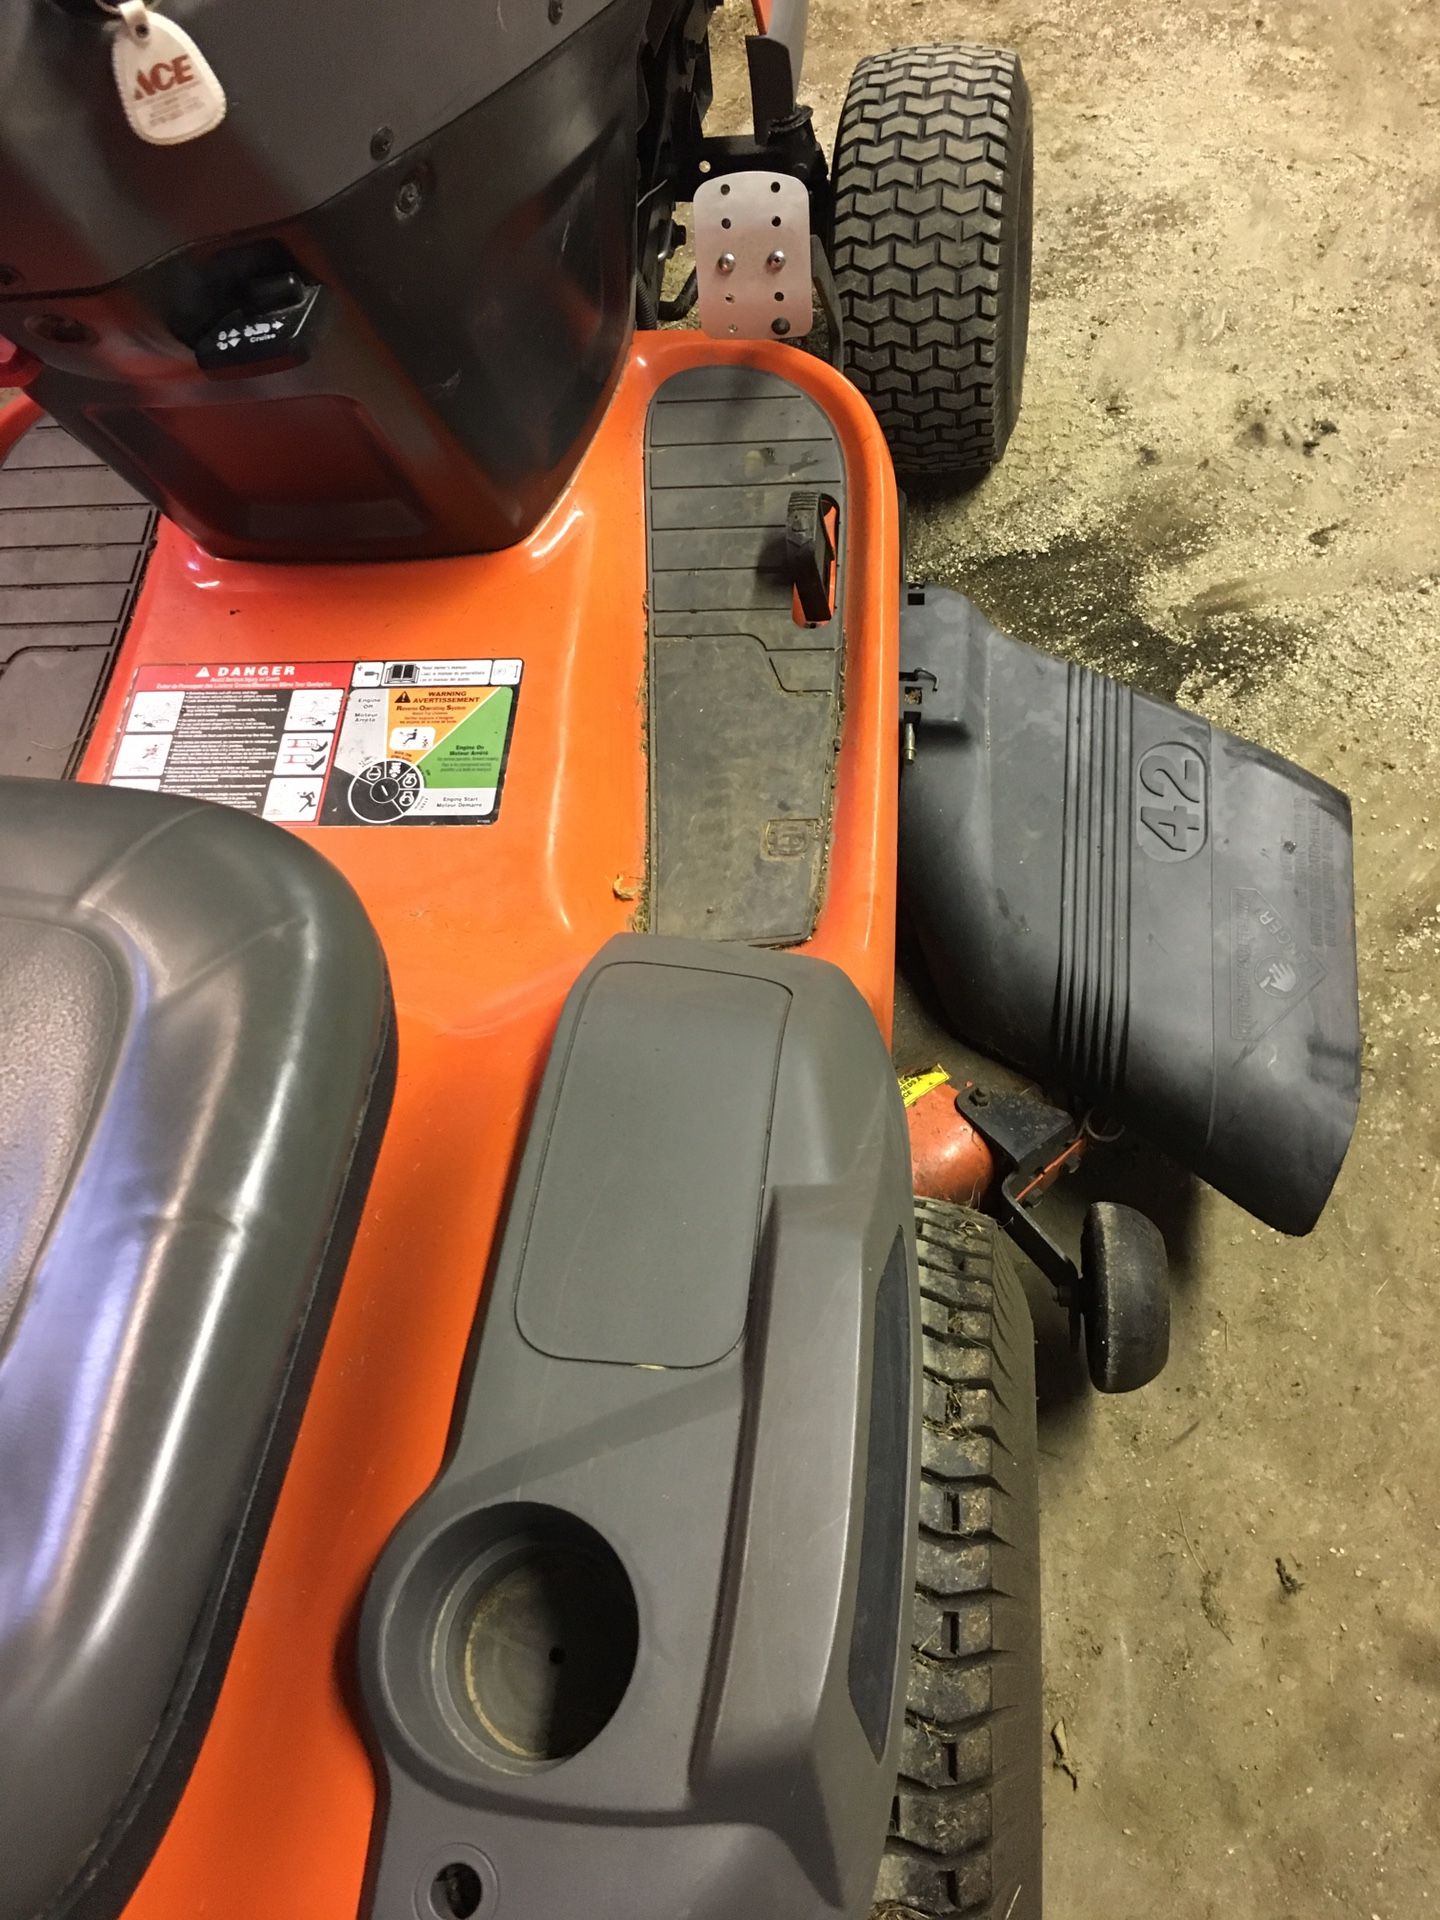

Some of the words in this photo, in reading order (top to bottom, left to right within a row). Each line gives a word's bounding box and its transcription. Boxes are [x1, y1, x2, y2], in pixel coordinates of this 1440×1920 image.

[134, 54, 194, 100] ACE
[249, 333, 276, 343] Cruise
[217, 665, 296, 677] DANGER
[1140, 755, 1200, 852] 42
[1259, 911, 1319, 979] DANGER
